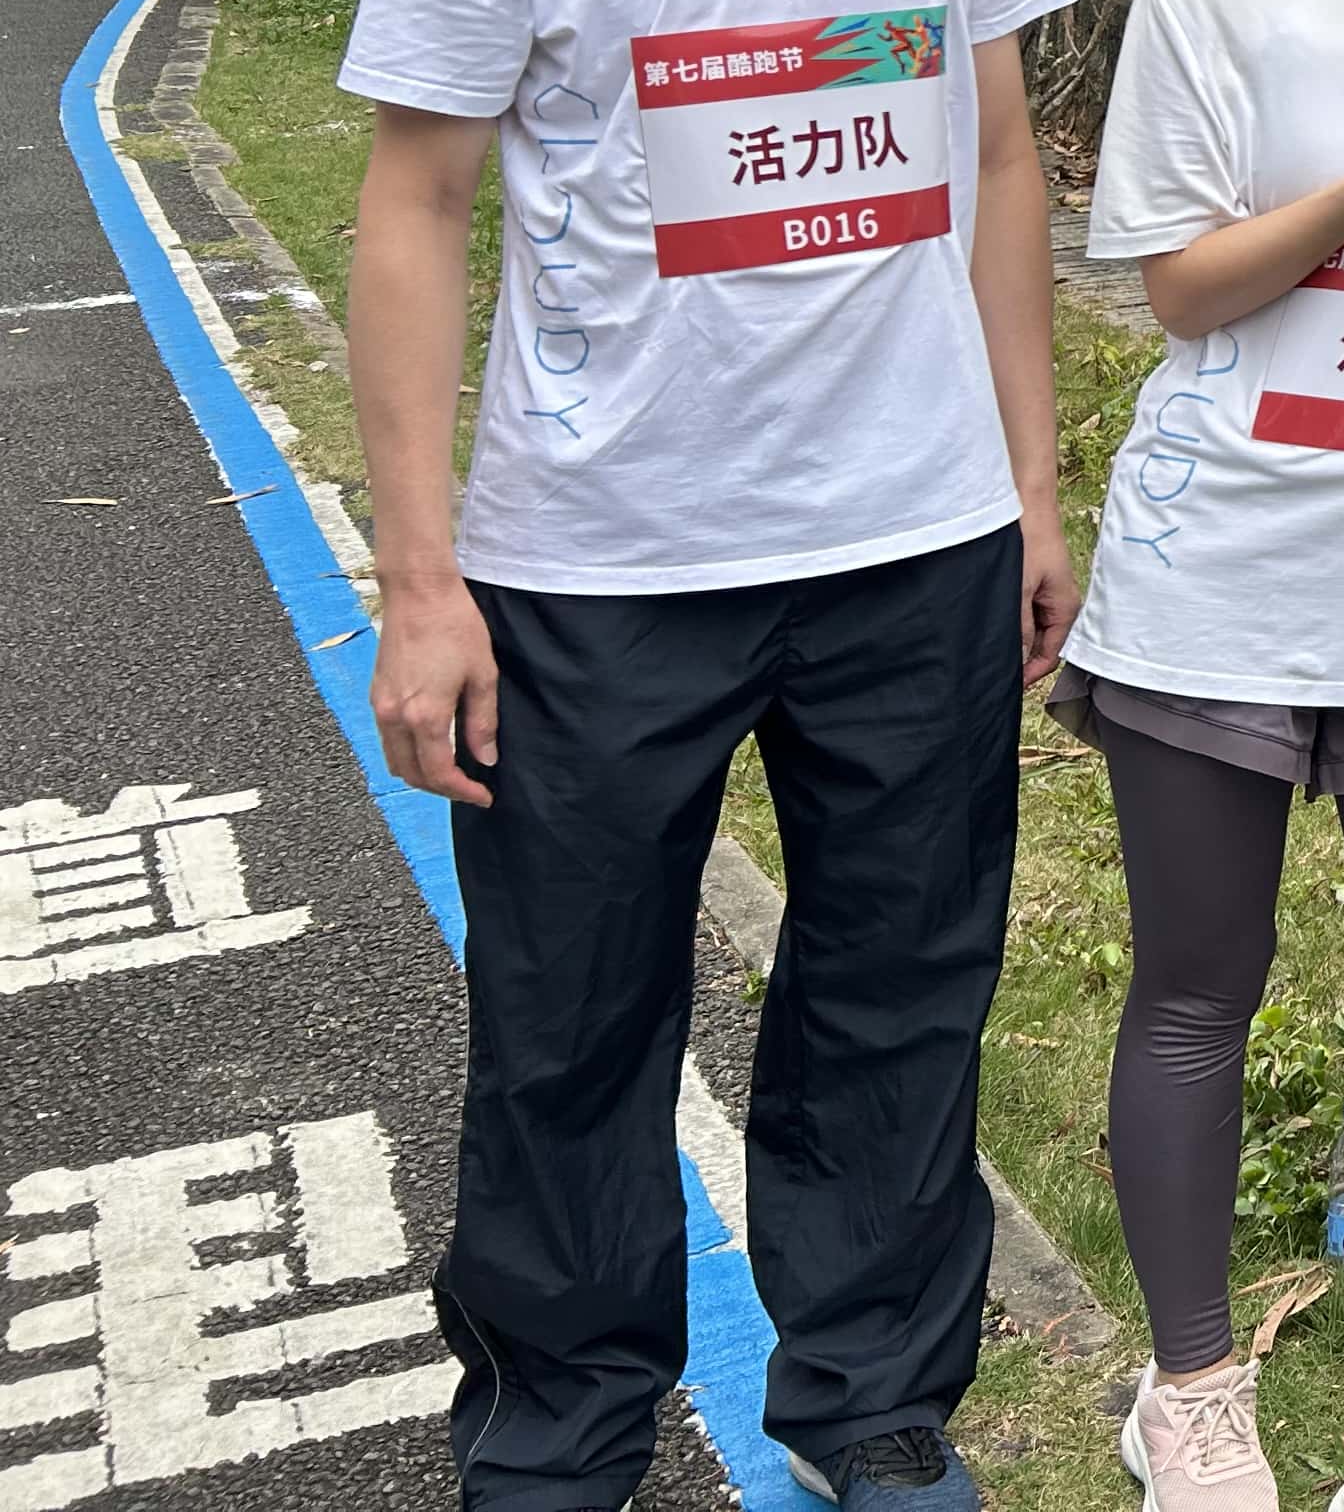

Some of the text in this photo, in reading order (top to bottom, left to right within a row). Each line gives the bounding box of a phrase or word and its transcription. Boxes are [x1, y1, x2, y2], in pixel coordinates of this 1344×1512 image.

[643, 46, 804, 88] 第七届酷跑节
[728, 110, 909, 185] 活力队
[783, 208, 880, 252] B016
